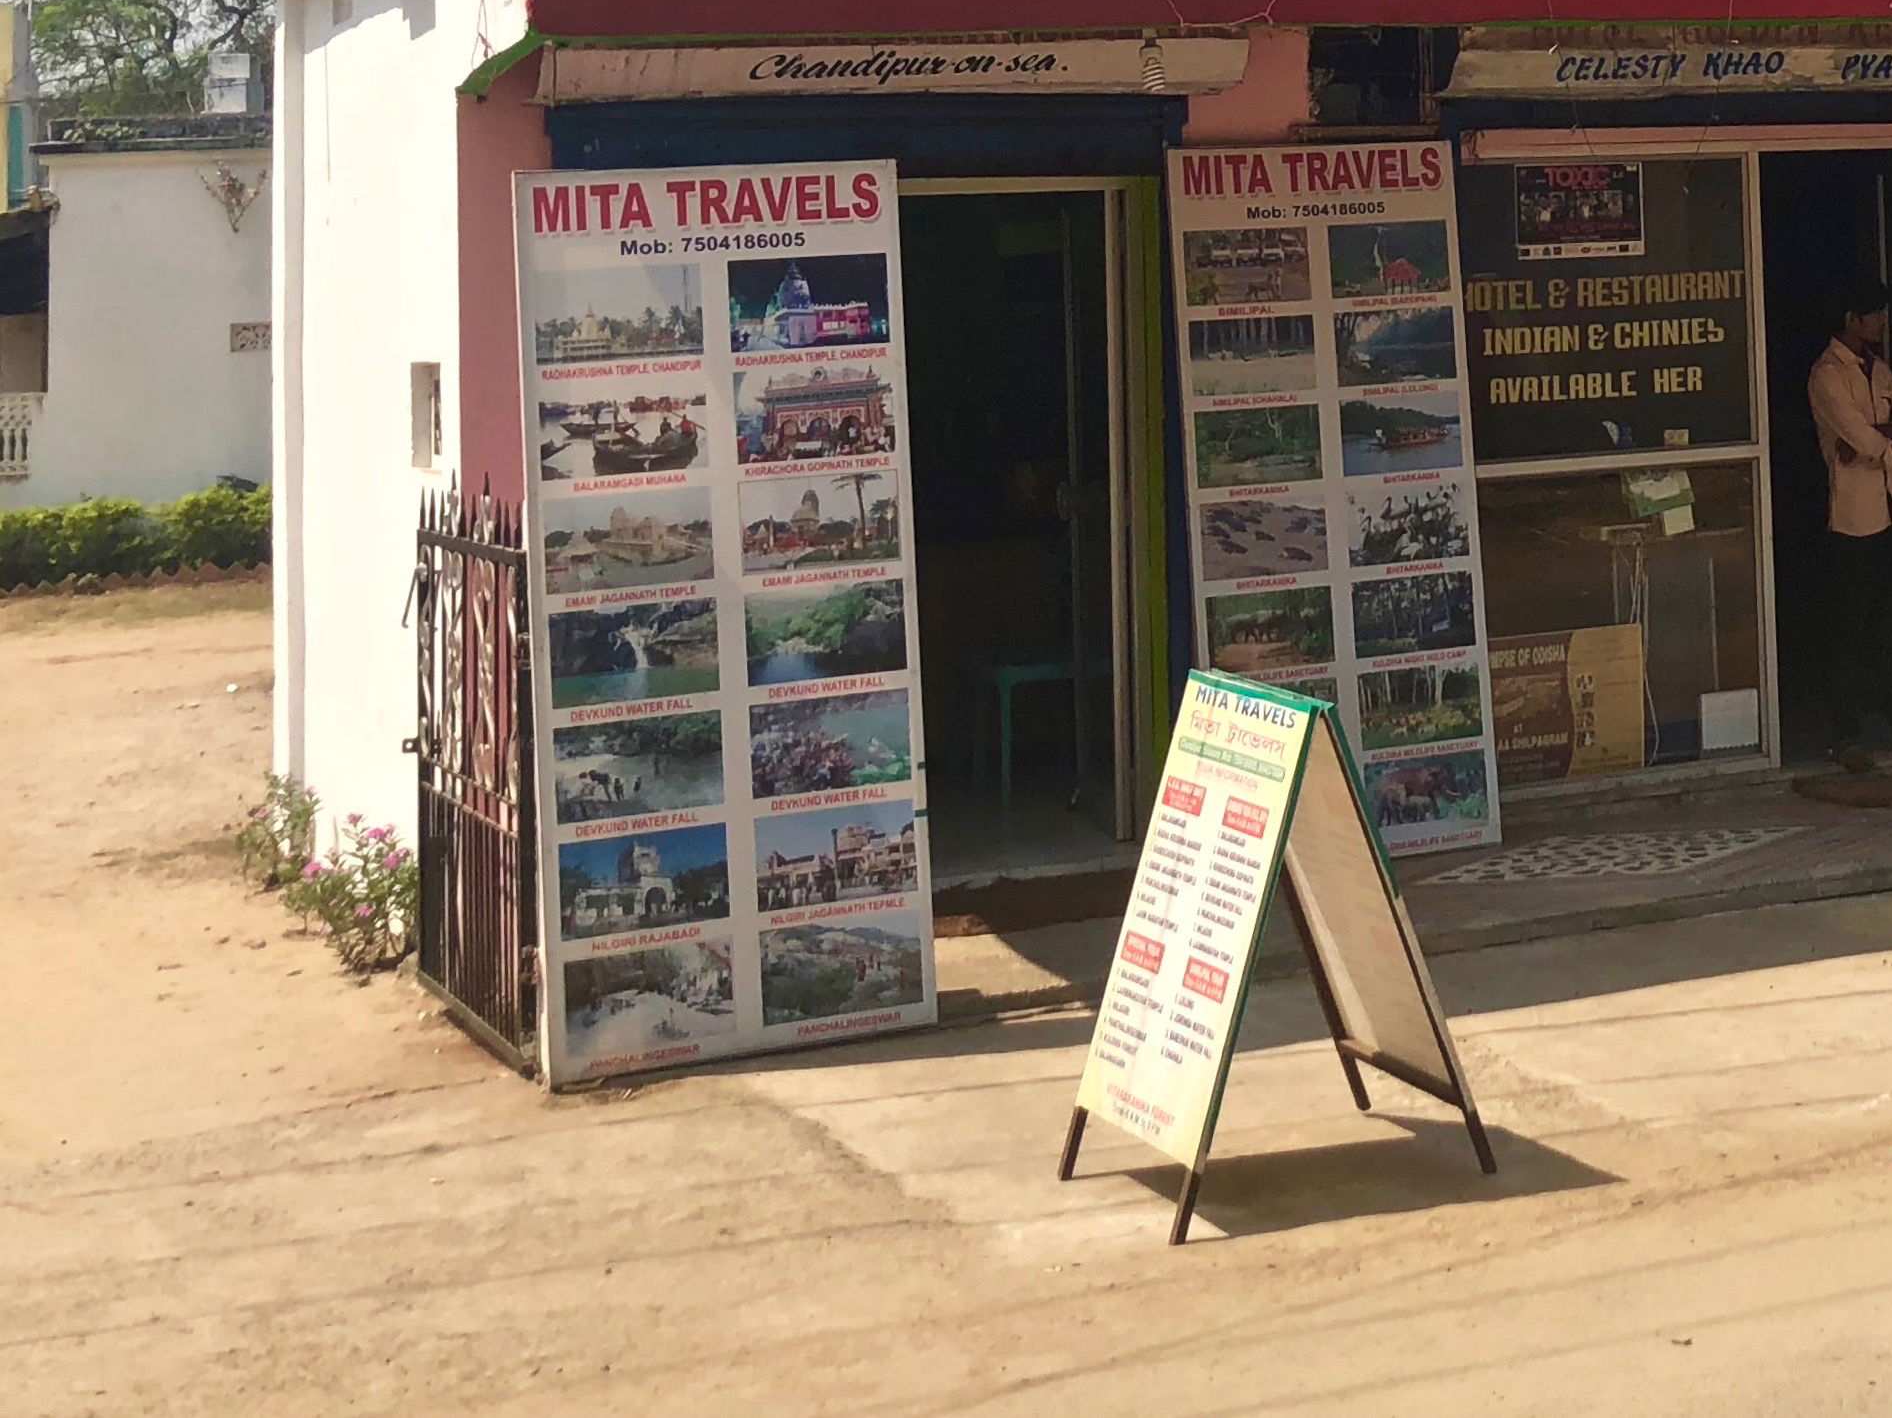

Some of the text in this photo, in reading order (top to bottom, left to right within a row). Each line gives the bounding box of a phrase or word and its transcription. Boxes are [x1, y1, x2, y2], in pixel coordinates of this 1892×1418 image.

[1556, 53, 1687, 82] CELESTY
[1702, 50, 1786, 81] KHAO
[1182, 147, 1442, 196] MITA TRAVELS
[532, 173, 880, 234] MITA TRAVELS
[1246, 201, 1386, 220] Mob: 7504186005
[620, 232, 806, 256] Mob: 7504186005
[1547, 278, 1571, 309] &
[1577, 269, 1745, 308] RESTAURANT
[1483, 317, 1725, 357] INDIAN & CHINIES
[840, 347, 887, 359] CHANDIPUR
[1490, 366, 1703, 404] AVAILABLE HER
[807, 460, 854, 472] GOPINATH
[855, 458, 890, 469] TEMPLE
[851, 566, 887, 579] TEMPLE
[599, 589, 657, 604] JAGANNATH
[659, 584, 697, 598] TEMPLE
[1532, 643, 1566, 665] ODISHA
[768, 675, 885, 699] DEVKUND WATER FALL
[570, 697, 693, 722] DEVKUND WATER FALL
[1195, 685, 1297, 729] MITA TRAVELS
[771, 786, 887, 811] DEVKUND WATER FALL
[575, 811, 698, 837] DEVKUND WATER FALL
